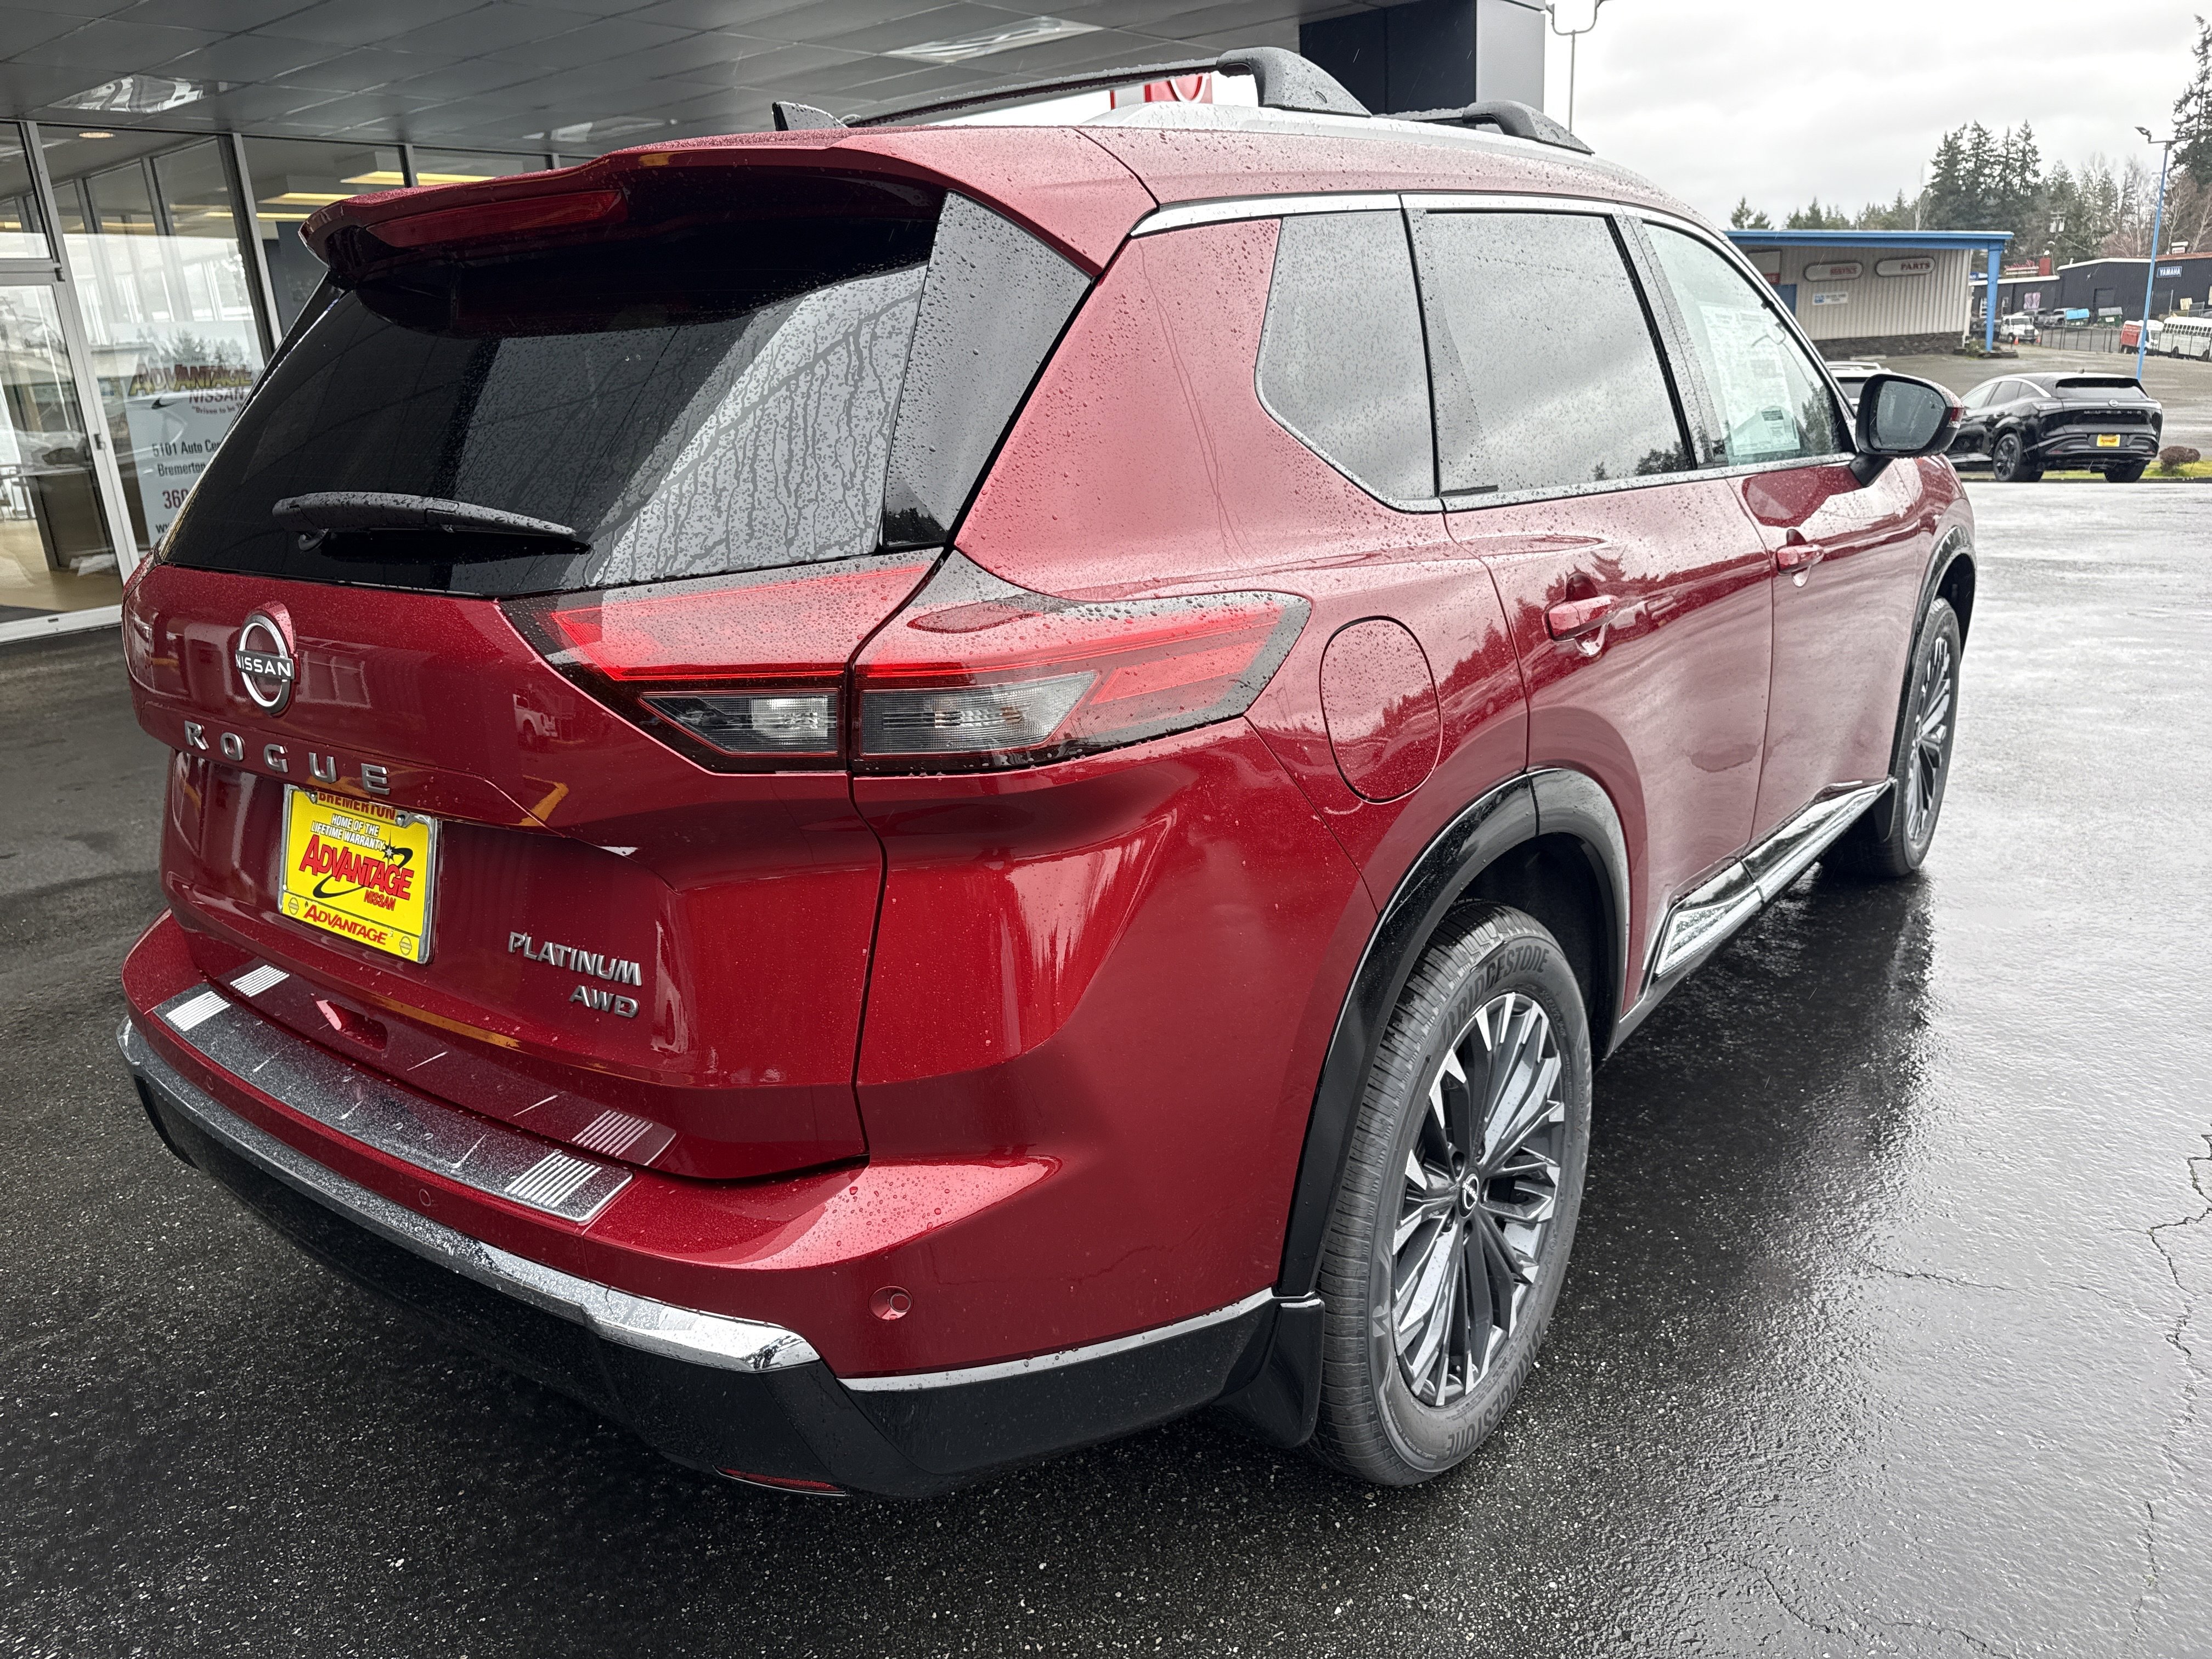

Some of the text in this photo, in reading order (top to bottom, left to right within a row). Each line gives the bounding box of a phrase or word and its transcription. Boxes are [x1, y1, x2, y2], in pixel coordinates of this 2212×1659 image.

[1900, 262, 1931, 271] PARTS
[2159, 268, 2181, 276] YAMAHA
[128, 363, 253, 396] ADVANTAGE
[189, 386, 244, 404] NISSAN
[152, 441, 178, 457] 5101
[181, 441, 203, 455] Auto
[235, 653, 291, 677] NISSAN
[184, 720, 390, 795] ROGUE
[311, 820, 343, 840] LIFETIME
[332, 813, 380, 837] HOME OF THE
[299, 834, 414, 900] ADVANTAGE
[364, 890, 397, 911] NISSAN
[303, 904, 389, 945] ADVANTAGE
[508, 931, 642, 986] PLATINUM
[568, 985, 639, 1018] AWD
[1441, 945, 1549, 1042] BRIDGESTONE
